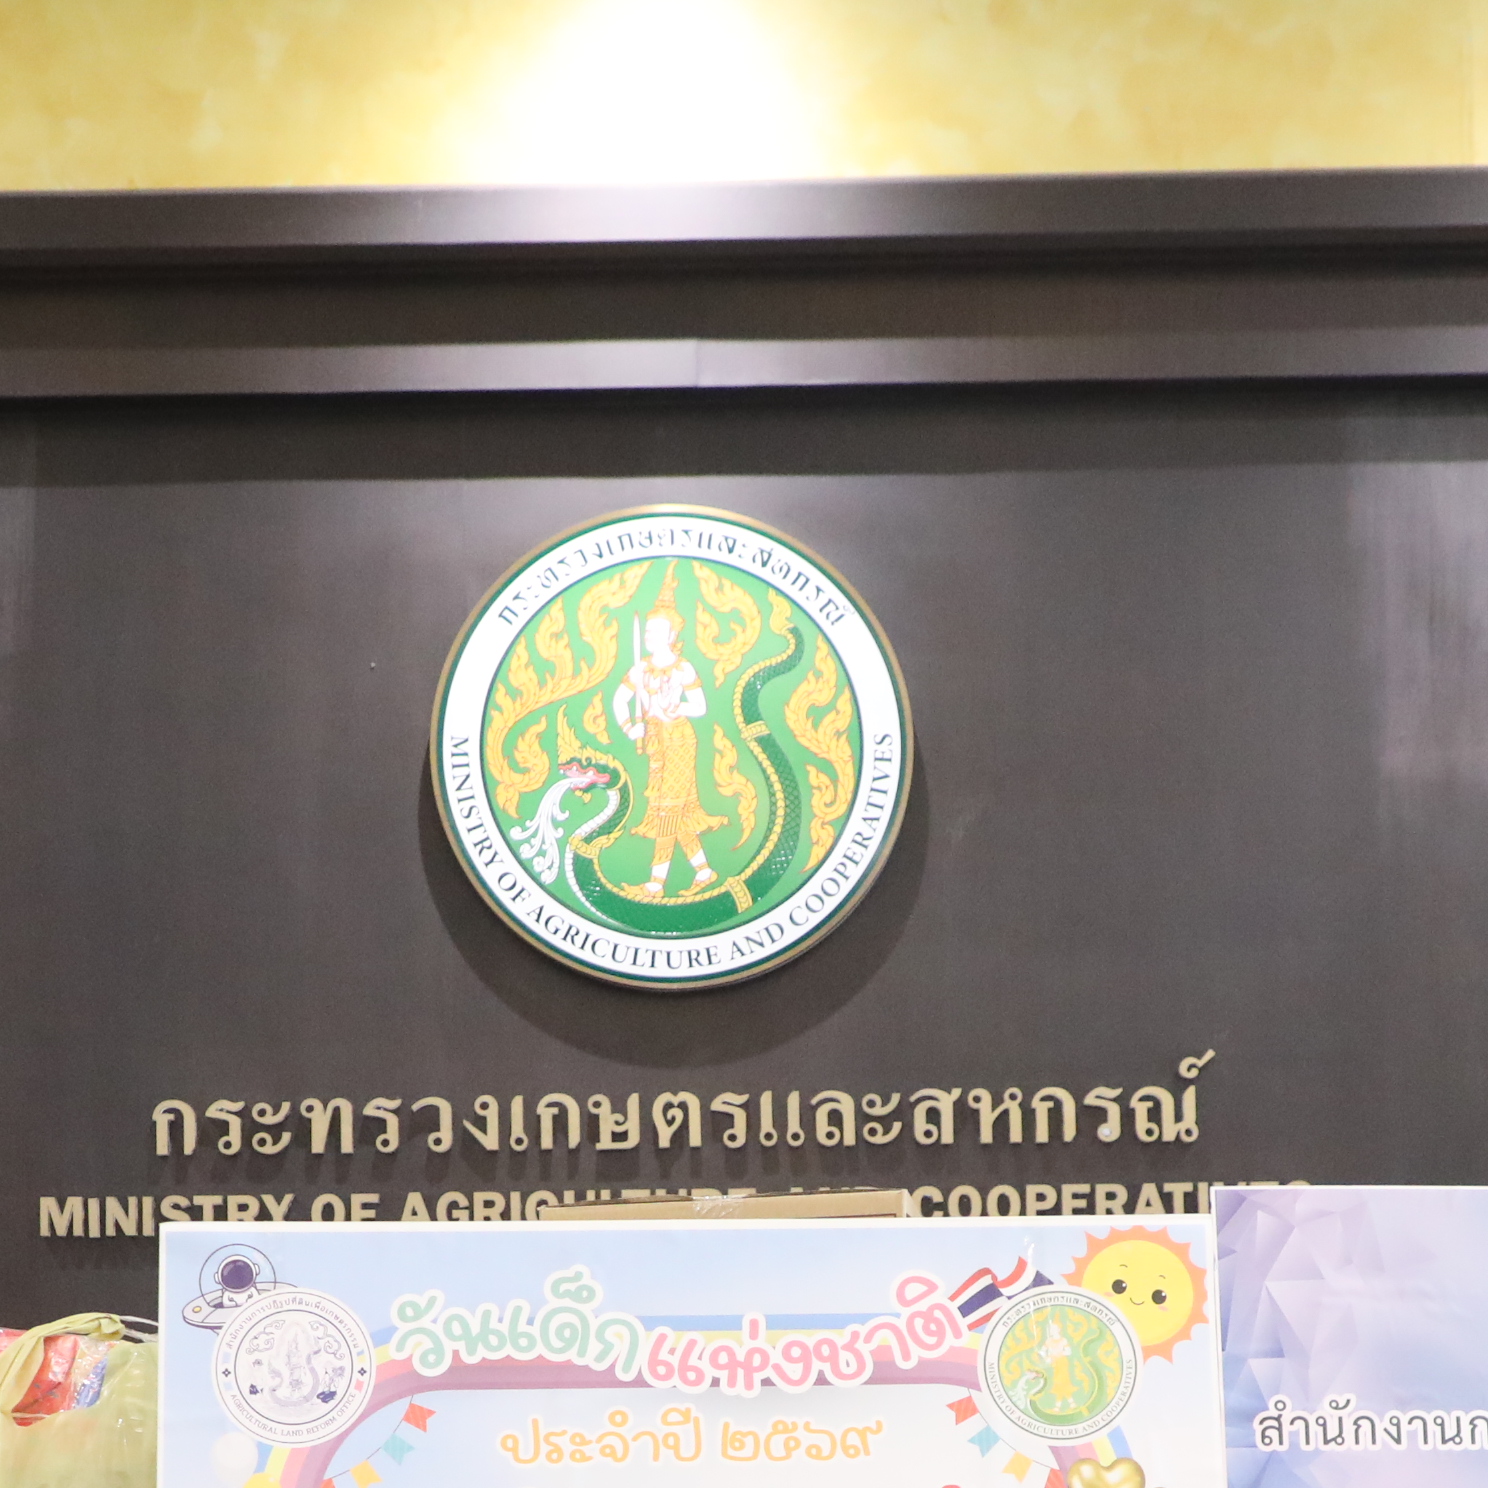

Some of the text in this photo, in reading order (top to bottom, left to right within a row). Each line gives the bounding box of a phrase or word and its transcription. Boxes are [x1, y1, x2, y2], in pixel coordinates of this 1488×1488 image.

[450, 732, 895, 970] MINISTRY OF AGRICULTURE AND COOPERATIVES
[150, 1048, 1217, 1156] กระทรวงเกษตรและสหกรณ์
[230, 1391, 358, 1438] AGRICULTURAL LAND REFORM OFFICE
[500, 1407, 884, 1464] ประจำปี ๒๕๖๙
[987, 1360, 1010, 1410] MINISTRY
[1014, 1413, 1081, 1437] AGRICULTURE
[1080, 1421, 1102, 1436] AND
[1098, 1358, 1134, 1428] COOPERATIVES
